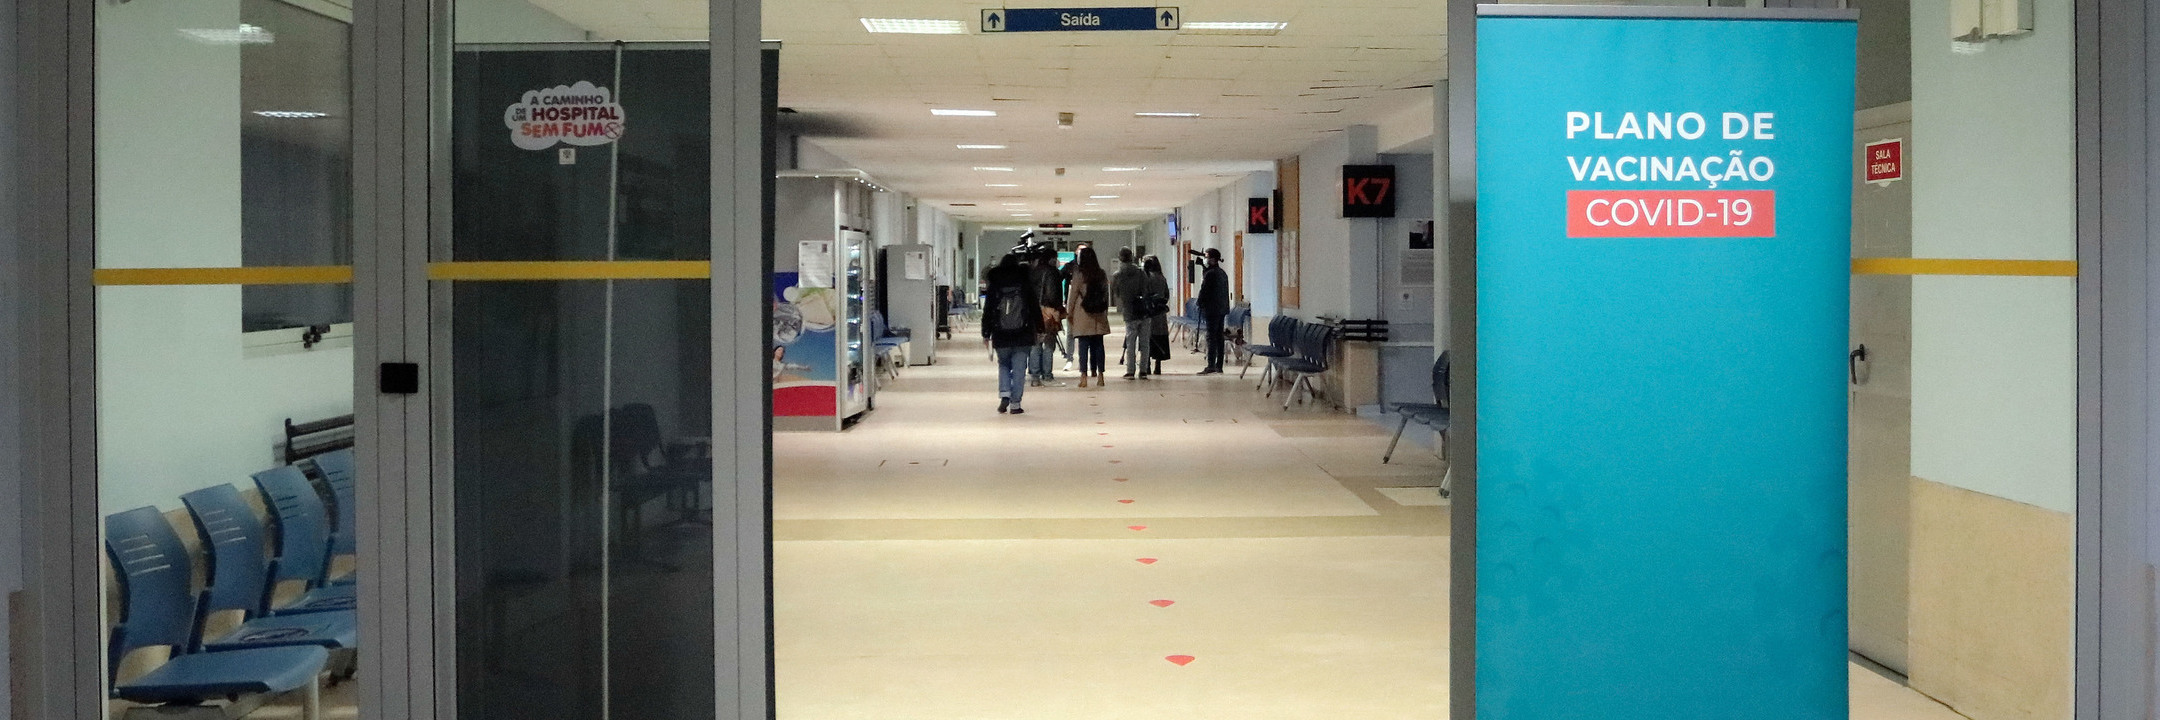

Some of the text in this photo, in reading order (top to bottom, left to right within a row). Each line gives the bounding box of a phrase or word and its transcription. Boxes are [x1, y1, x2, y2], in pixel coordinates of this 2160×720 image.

[1060, 13, 1100, 26] Saída
[530, 95, 604, 105] A CAMINHO
[532, 106, 619, 121] HOSPITAL
[521, 122, 559, 138] SEM
[1566, 111, 1775, 140] PLANO DE
[1875, 149, 1891, 160] SALA
[1566, 150, 1775, 189] VACINAÇÃO
[1871, 162, 1896, 174] TÉCNICA
[1347, 177, 1390, 205] K7
[1251, 206, 1267, 225] K
[1586, 198, 1753, 226] COVID-19
